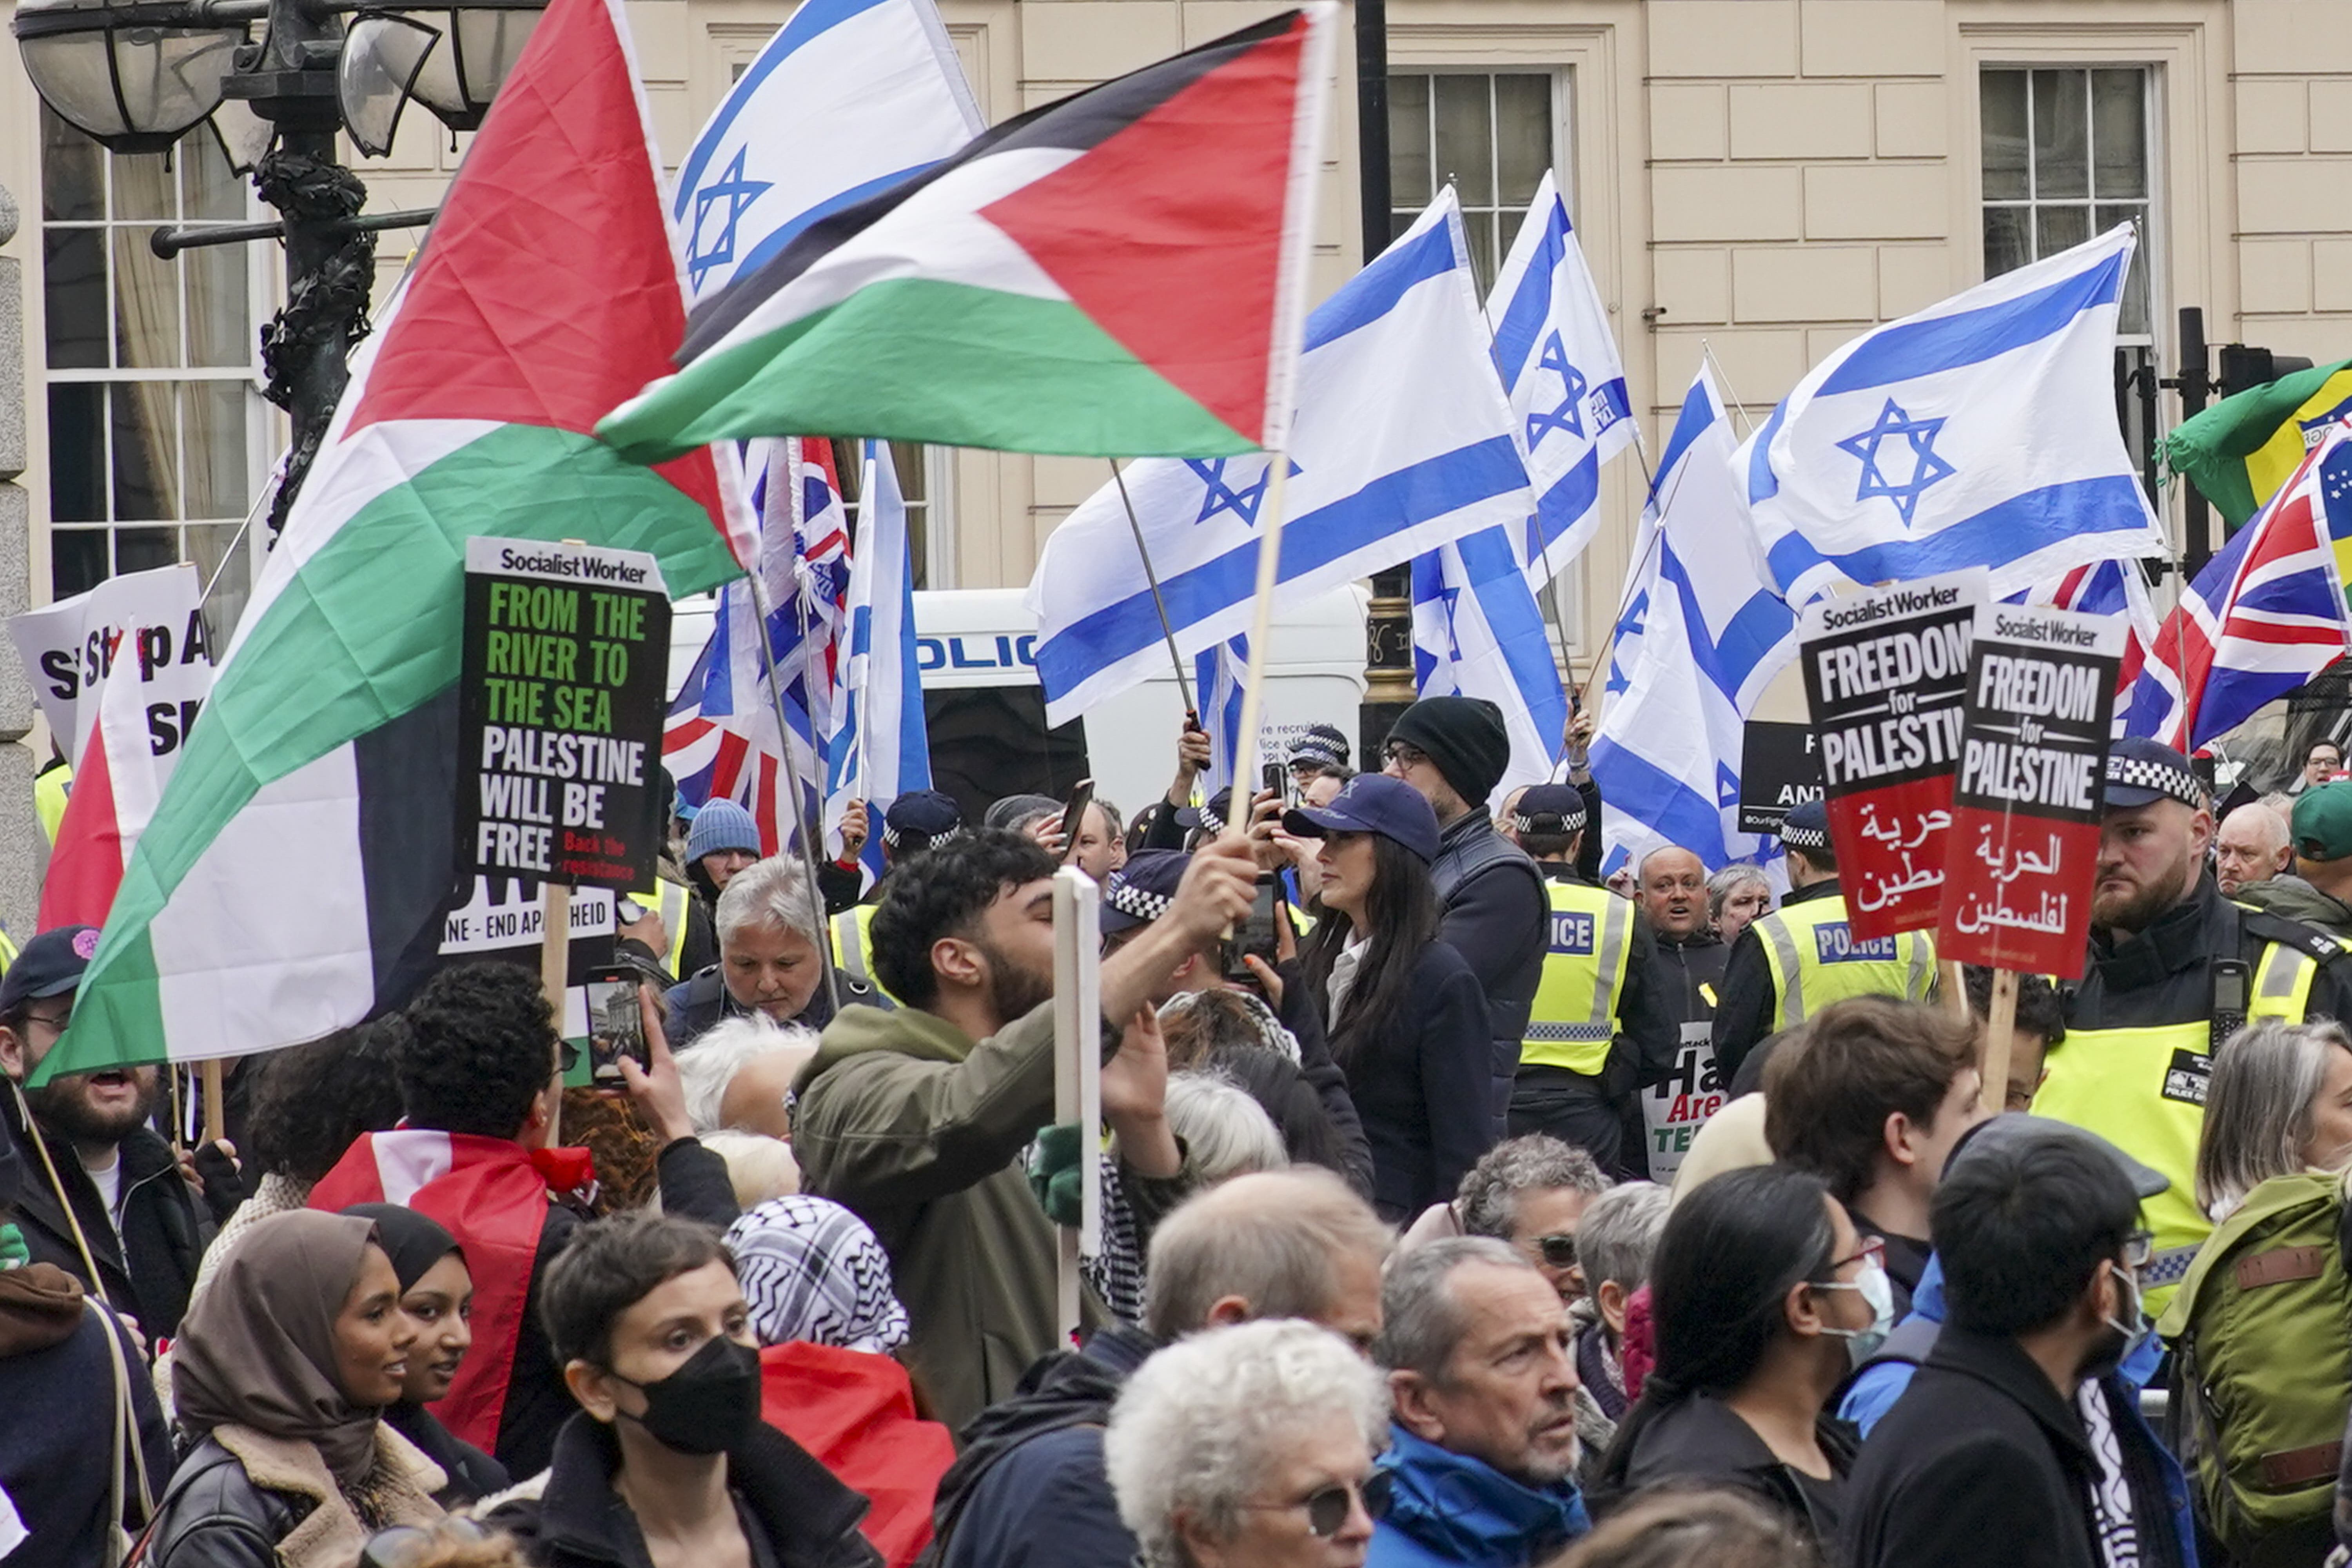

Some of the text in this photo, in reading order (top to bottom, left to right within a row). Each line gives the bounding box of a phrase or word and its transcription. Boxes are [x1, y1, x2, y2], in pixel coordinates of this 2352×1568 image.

[501, 548, 647, 584] Socialist Worker
[489, 582, 647, 641] FROM THE
[1822, 587, 1959, 630] Socialist Worker
[1995, 614, 2098, 647] Socialist Worker
[487, 630, 628, 687] RIVER TO
[1817, 619, 1974, 703] FREEDOM
[485, 678, 612, 733] THE SEA
[1888, 690, 1917, 715] for
[1977, 654, 2100, 722] FREEDOM
[482, 726, 645, 786] PALESTINE
[2021, 716, 2045, 744] for
[479, 773, 605, 829] WILL BE
[1961, 739, 2098, 810] PALESTINE
[477, 821, 553, 872] FREE
[1976, 824, 2062, 882] الحرية
[486, 913, 517, 939] END
[1956, 883, 2068, 935] لفلسطين
[1666, 1094, 1722, 1123] Are
